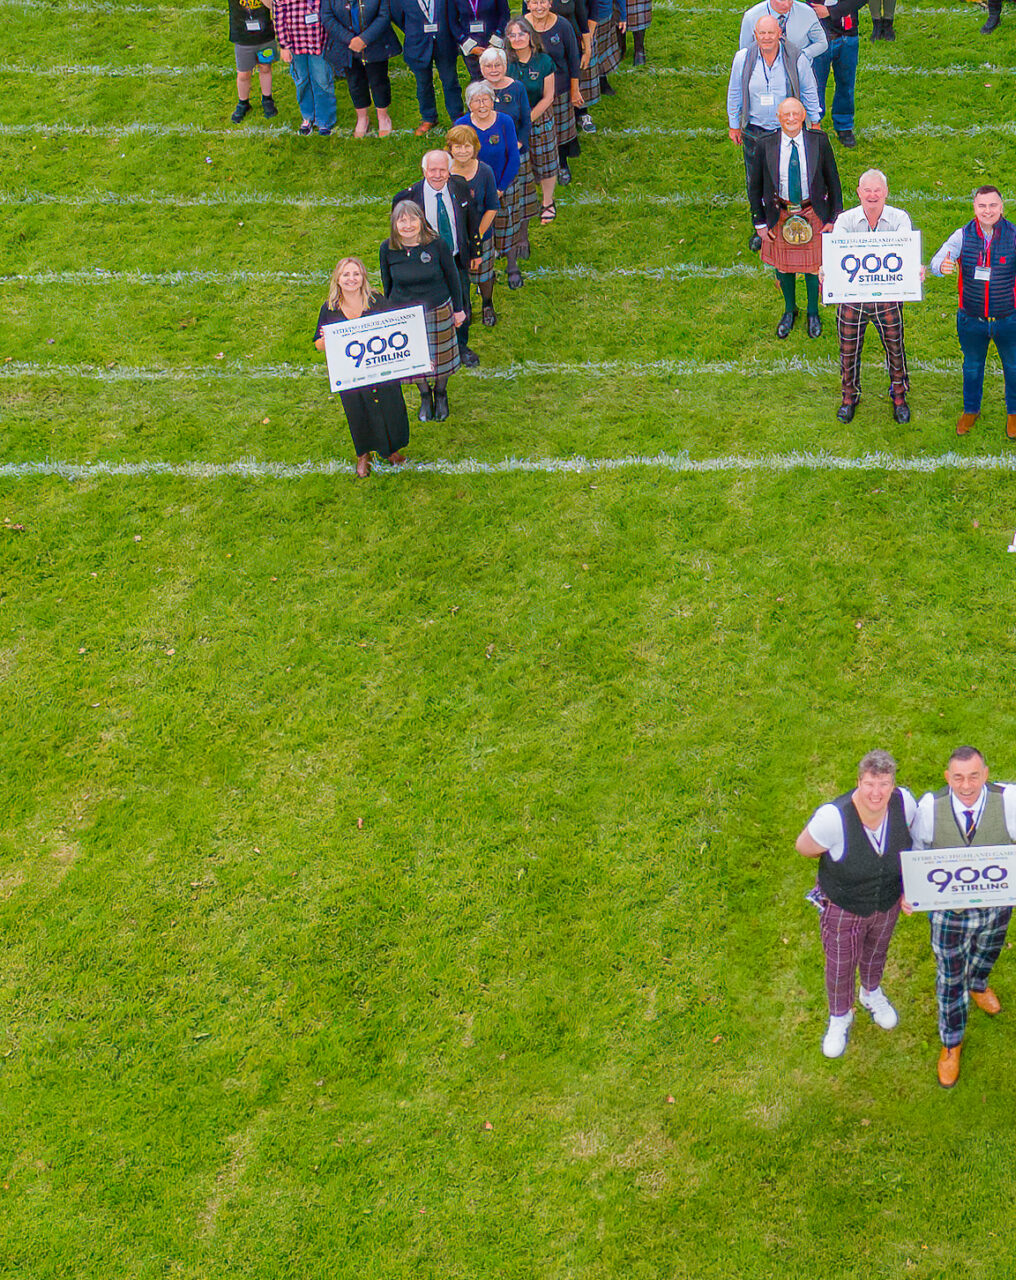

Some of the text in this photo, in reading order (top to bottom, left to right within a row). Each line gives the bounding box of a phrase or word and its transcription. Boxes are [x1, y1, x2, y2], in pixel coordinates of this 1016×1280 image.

[841, 252, 903, 283] 900
[858, 273, 904, 283] STIRLING
[345, 331, 409, 368] 900
[365, 350, 411, 366] STIRLING
[927, 865, 1008, 893] 900
[951, 882, 1009, 893] STIRLING
